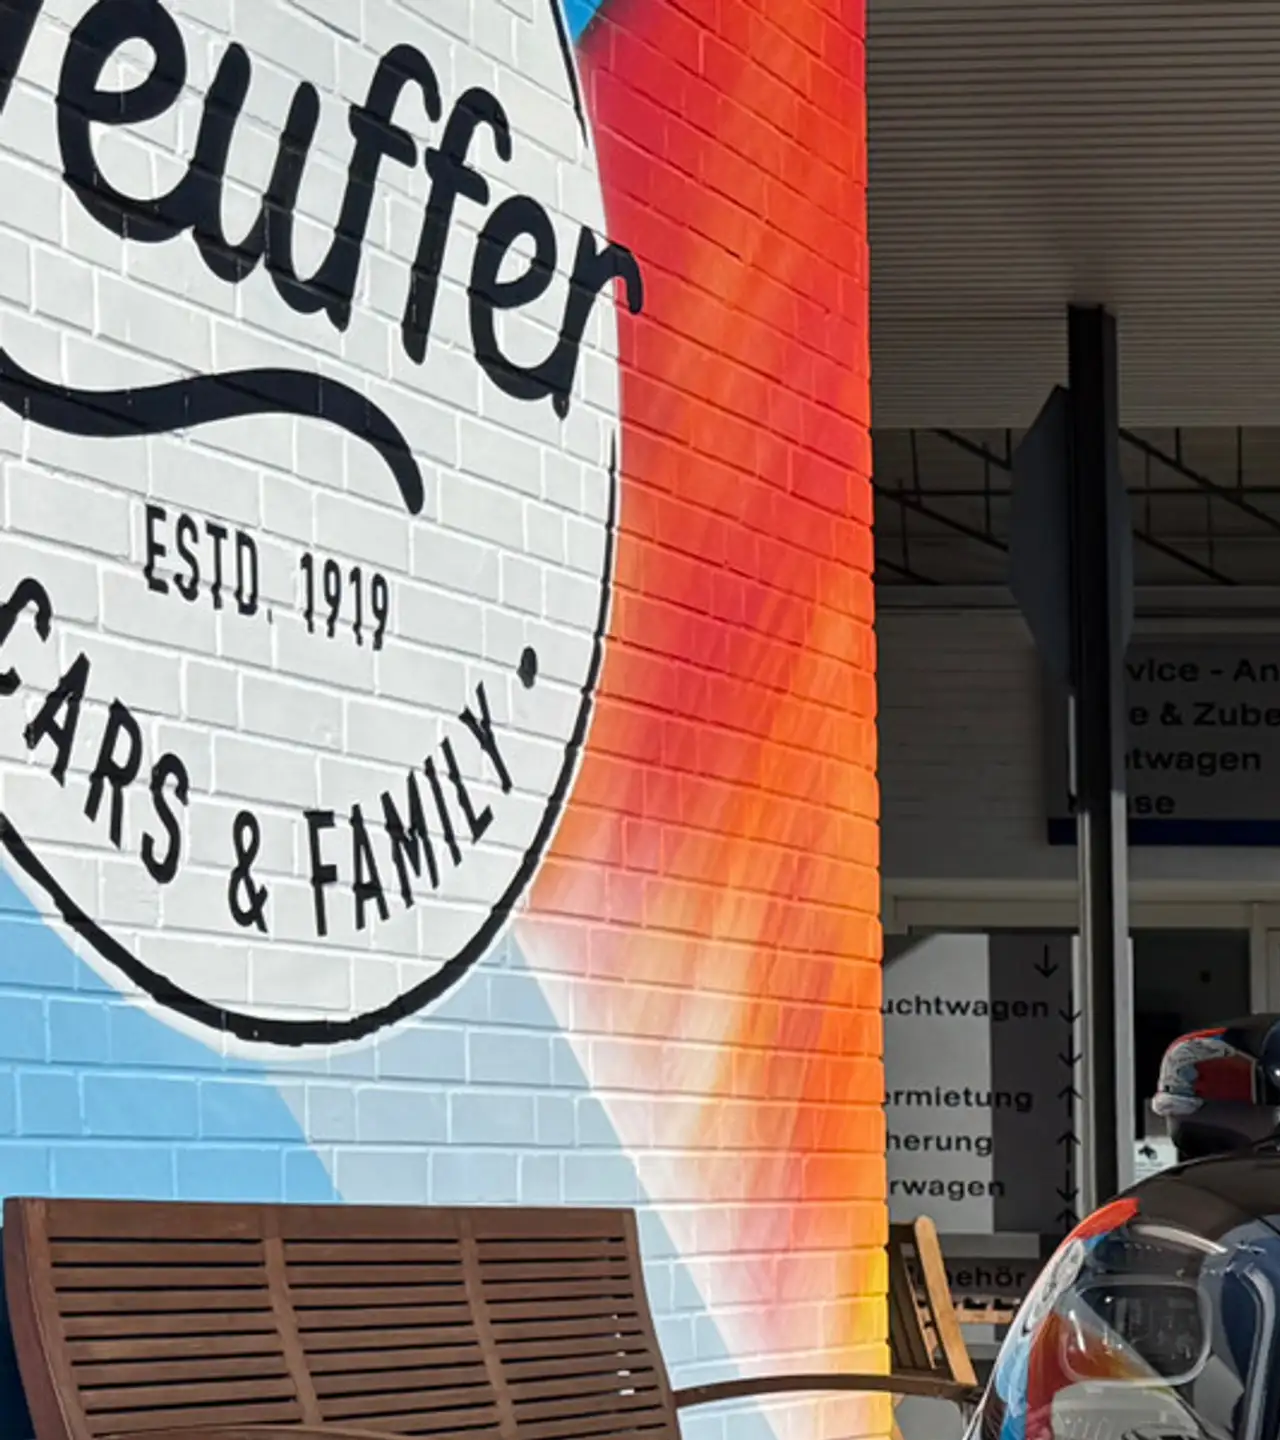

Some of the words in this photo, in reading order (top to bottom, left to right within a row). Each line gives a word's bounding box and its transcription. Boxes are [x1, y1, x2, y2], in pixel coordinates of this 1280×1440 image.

[143, 504, 273, 625] ESTD.
[300, 552, 390, 651] 1919
[1126, 658, 1200, 683] vice
[1159, 701, 1184, 726] &
[228, 810, 269, 934] &
[304, 682, 513, 937] FAMILY
[880, 994, 1049, 1022] uchtwagen
[885, 1129, 993, 1157] herung
[889, 1179, 1006, 1201] rwagen
